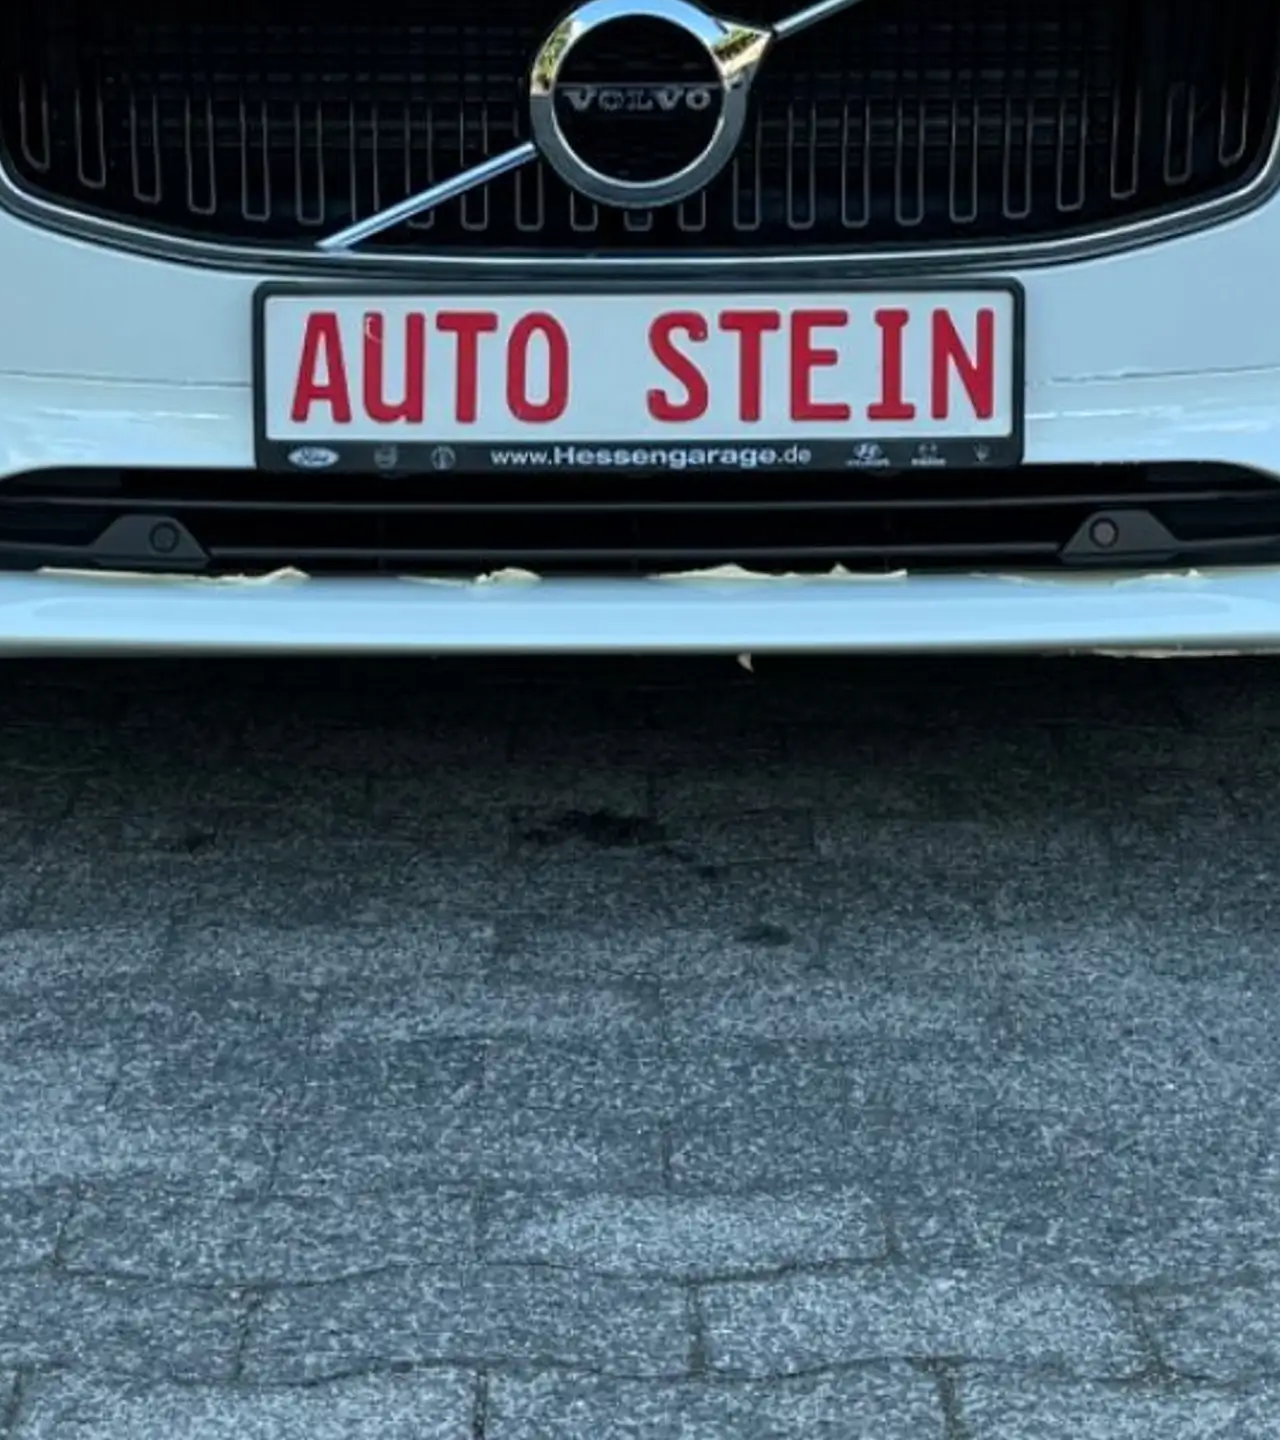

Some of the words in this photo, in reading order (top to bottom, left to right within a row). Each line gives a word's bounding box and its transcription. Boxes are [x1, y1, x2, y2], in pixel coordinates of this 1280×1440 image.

[562, 87, 712, 111] VOLVO
[290, 311, 569, 424] AUTO
[646, 307, 995, 422] STEIN
[489, 445, 812, 469] www.Hessengarage.de
